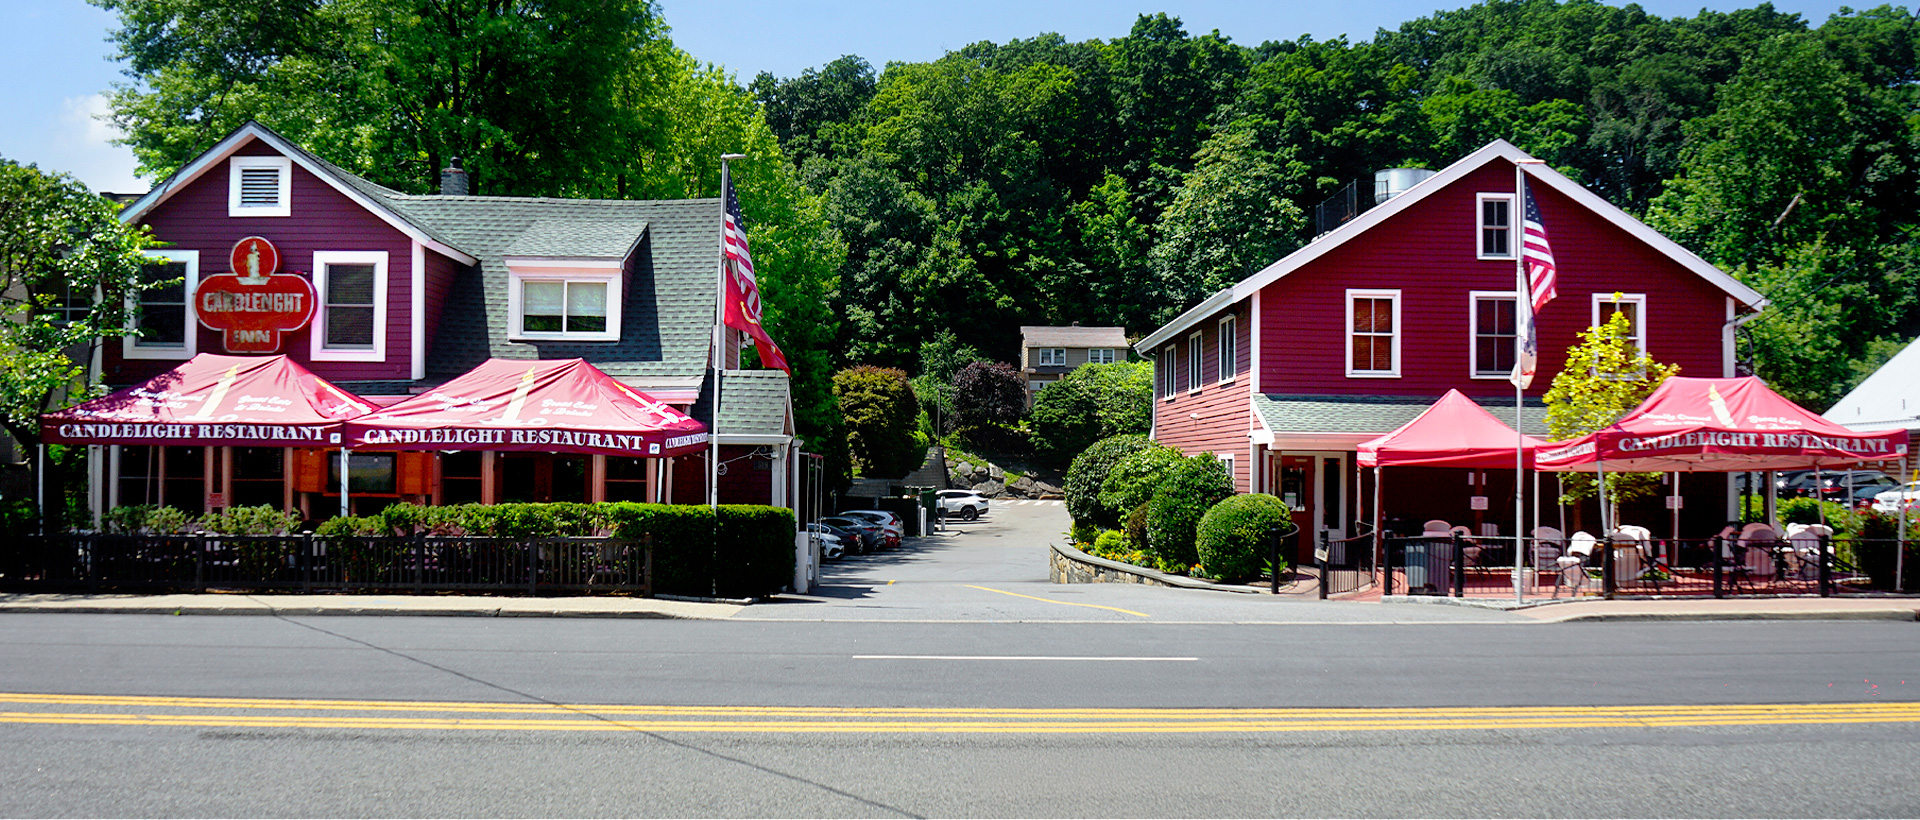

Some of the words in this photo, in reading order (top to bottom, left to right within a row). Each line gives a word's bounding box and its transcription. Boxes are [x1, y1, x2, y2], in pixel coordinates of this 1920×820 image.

[59, 423, 193, 440] CANDLELIGHT
[197, 424, 325, 441] RESTAURANT
[364, 429, 505, 445] CANDLELIGHT
[511, 429, 643, 450] RESTAURANT
[1618, 431, 1759, 452] CANDLELIGHT
[1764, 433, 1889, 453] RESTAURANT
